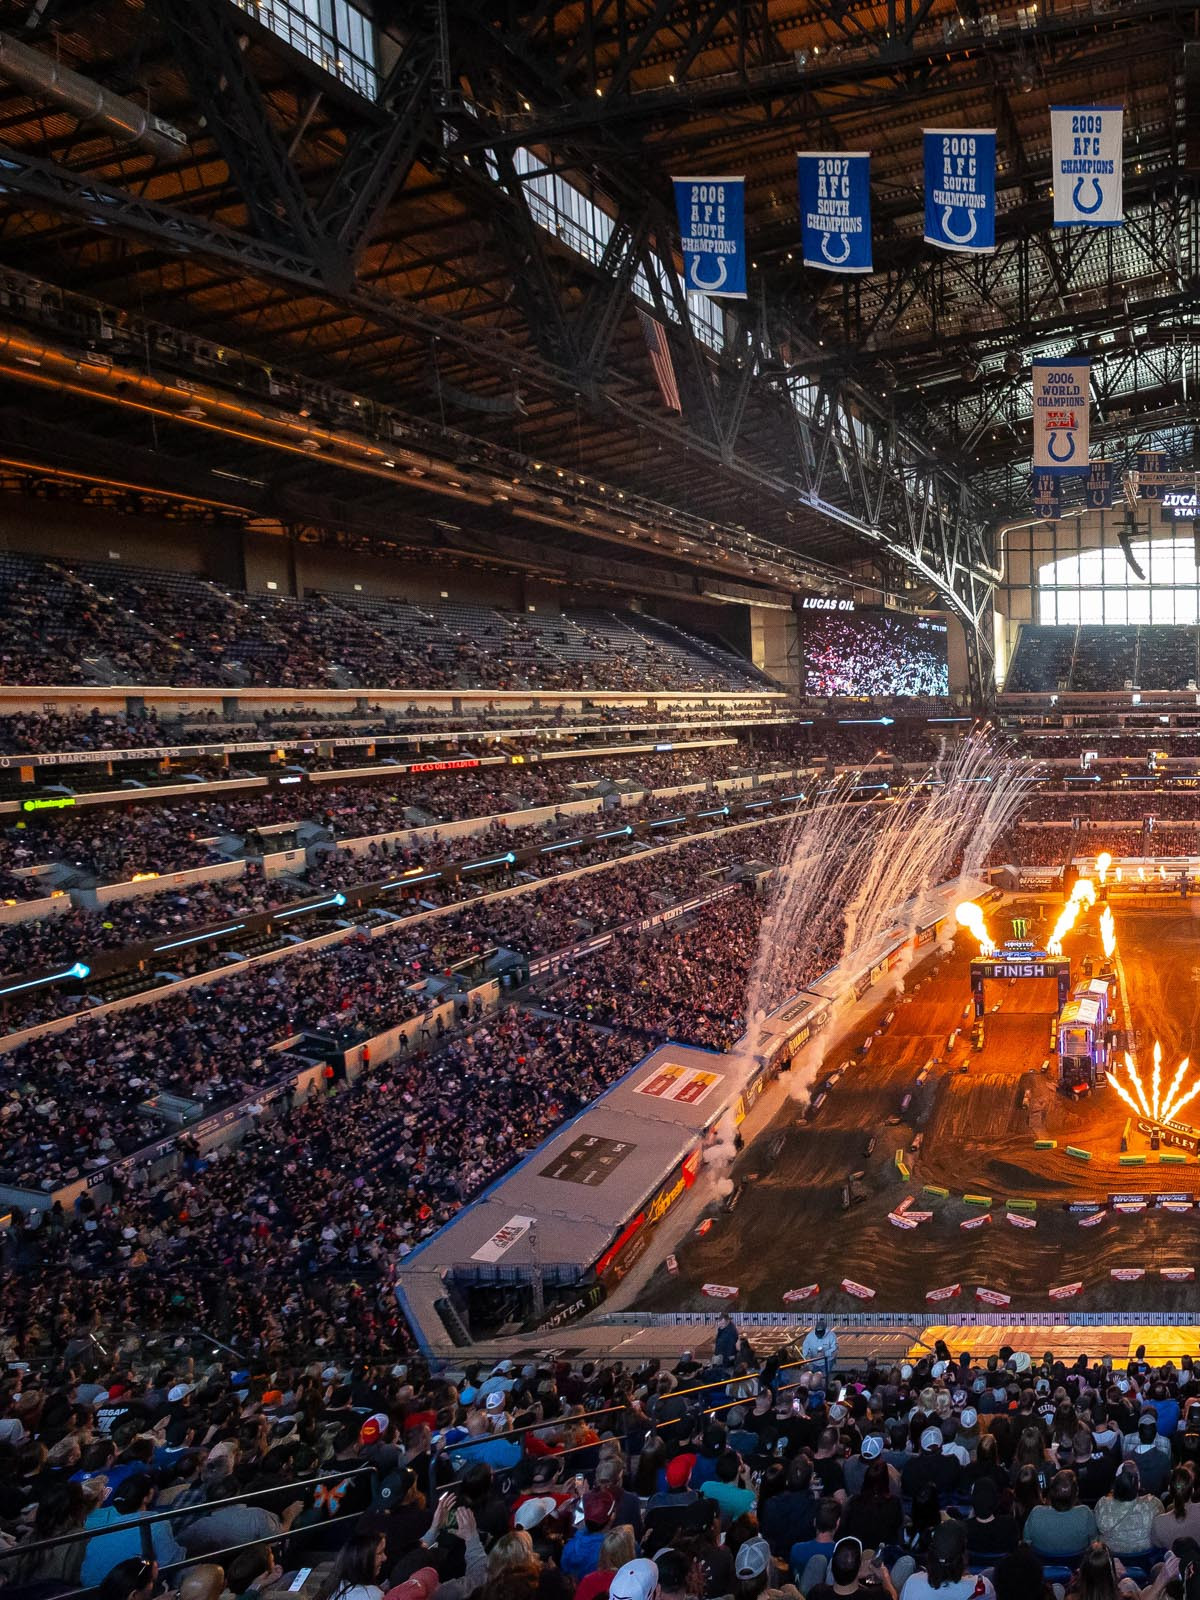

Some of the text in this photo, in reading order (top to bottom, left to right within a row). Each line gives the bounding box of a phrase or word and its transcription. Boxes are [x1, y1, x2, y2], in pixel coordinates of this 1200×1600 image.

[1072, 116, 1102, 133] 2009
[942, 138, 976, 156] 2009
[1073, 137, 1100, 156] AFC
[818, 160, 848, 176] 2007
[943, 157, 977, 176] AFC
[1060, 160, 1114, 174] CHAMPIONS
[818, 176, 850, 198] AFC
[943, 176, 976, 192] SOUTH
[691, 186, 725, 204] 2006
[933, 190, 986, 208] CHAMPIONS
[691, 205, 725, 223] AFC
[817, 200, 850, 216] SOUTH
[806, 213, 862, 233] CHAMPIONS
[691, 224, 725, 239] SOUTH
[681, 237, 736, 254] CHAMPIONS
[1047, 373, 1074, 384] 2006
[1042, 386, 1080, 396] WORLD
[1037, 397, 1085, 407] CHAMPIONS
[802, 598, 855, 611] LUCAS OIL
[38, 756, 56, 765] TED
[58, 752, 123, 764] MARCHIBRODA
[410, 760, 480, 772] LUCAS OIL STADIUM
[994, 965, 1044, 976] FINISH
